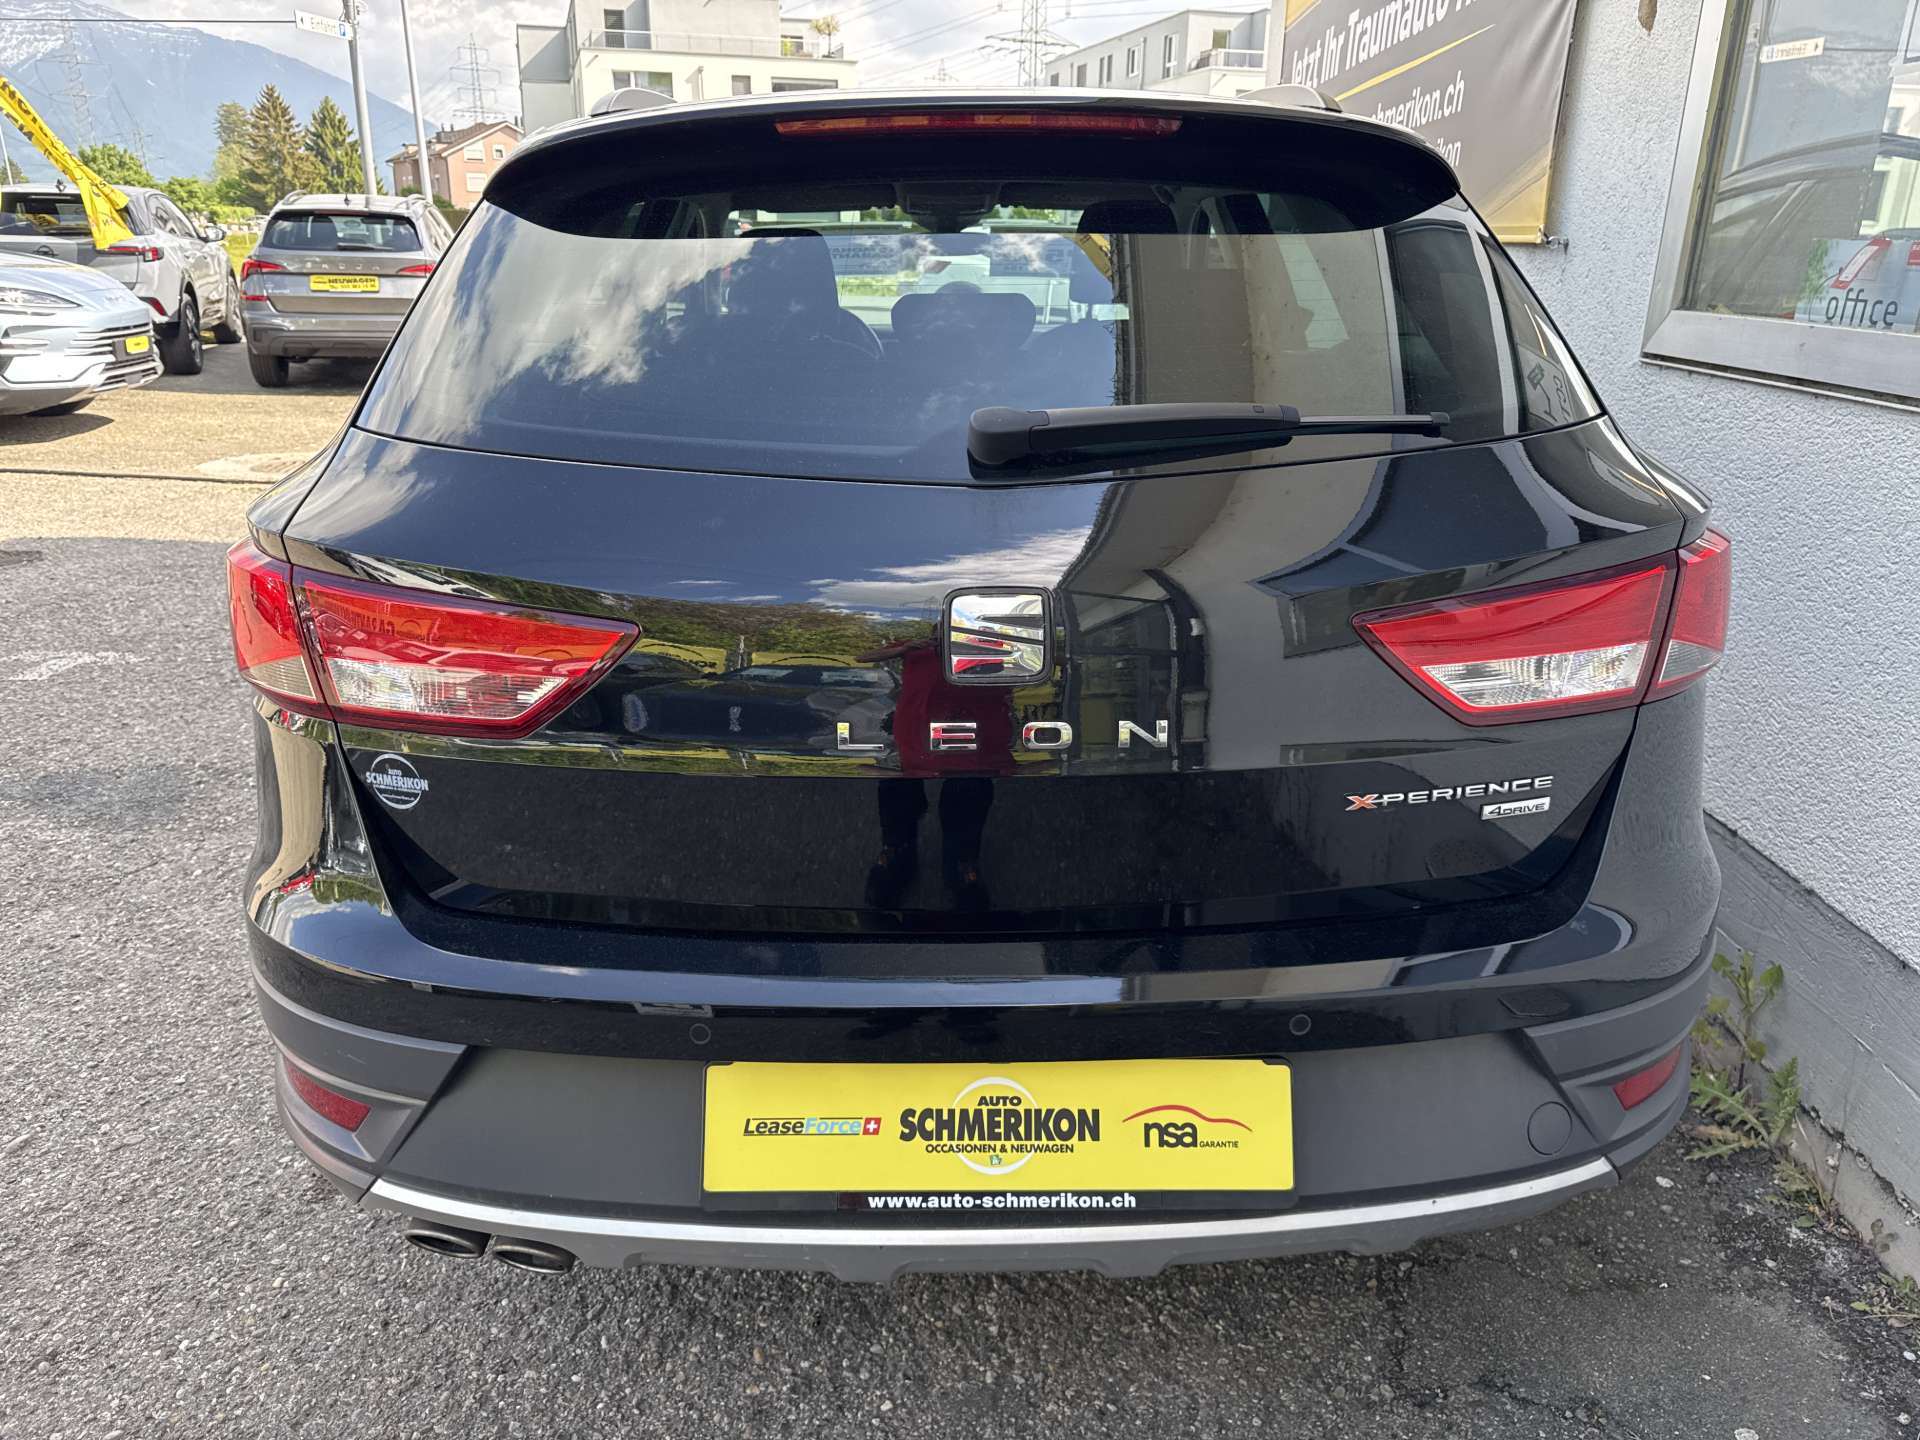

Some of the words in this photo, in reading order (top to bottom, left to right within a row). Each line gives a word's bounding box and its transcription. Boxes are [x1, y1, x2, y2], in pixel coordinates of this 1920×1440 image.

[1320, 25, 1345, 84] Ihr
[1825, 287, 1898, 327] office
[836, 719, 1169, 751] LEON
[365, 771, 430, 792] SCHMERIKON
[1487, 802, 1546, 817] 4DRIVE
[977, 1095, 1023, 1107] AUTO
[743, 1117, 862, 1136] LeaseForce
[898, 1107, 1101, 1142] SCHMERIKON
[1143, 1121, 1198, 1149] nsa
[1199, 1140, 1239, 1149] GARANTIE
[925, 1143, 997, 1154] OCCASIONEN
[999, 1143, 1009, 1154] &
[1010, 1143, 1075, 1154] NEUWAGEN
[867, 1192, 1137, 1209] www.auto-schmerikon.ch
